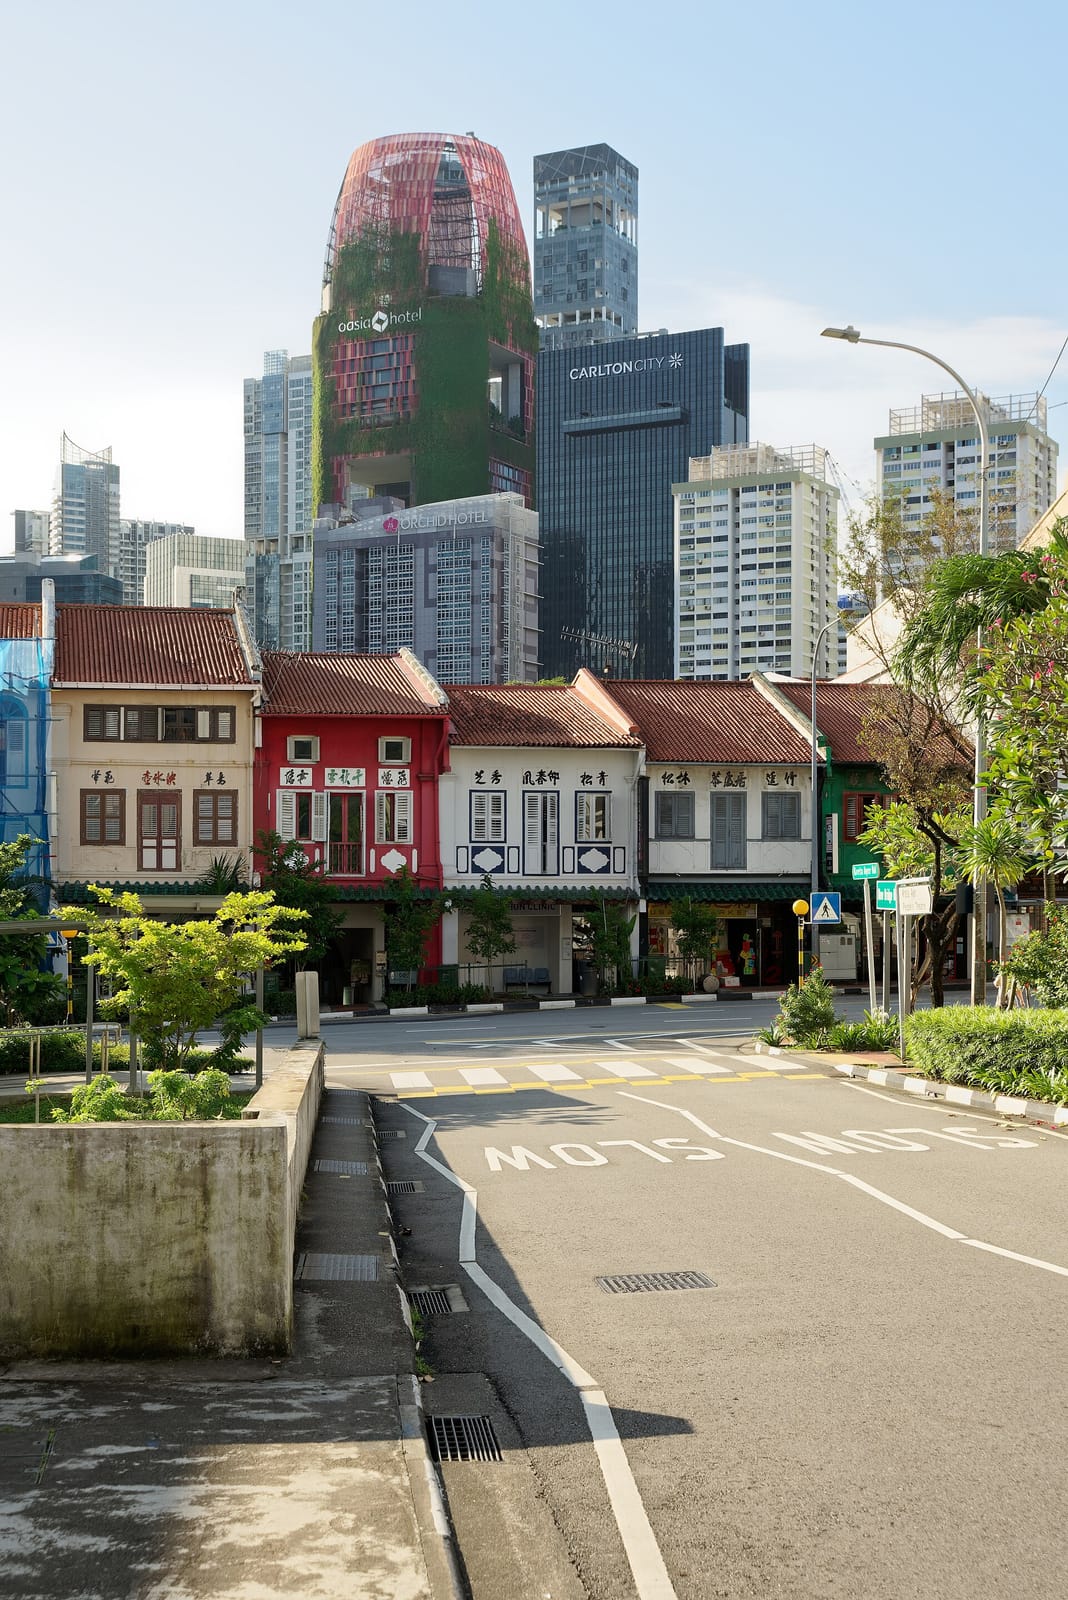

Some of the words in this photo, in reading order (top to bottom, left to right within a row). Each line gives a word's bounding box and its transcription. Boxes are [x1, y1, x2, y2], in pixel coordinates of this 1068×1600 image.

[338, 316, 371, 333] oasia
[390, 307, 422, 325] hotel
[569, 361, 633, 380] CARLTON
[634, 356, 665, 372] CITY
[400, 514, 447, 530] ORCHID
[448, 511, 489, 526] HOTEL
[484, 1137, 726, 1171] SLOW
[771, 1127, 1039, 1155] SLOW
